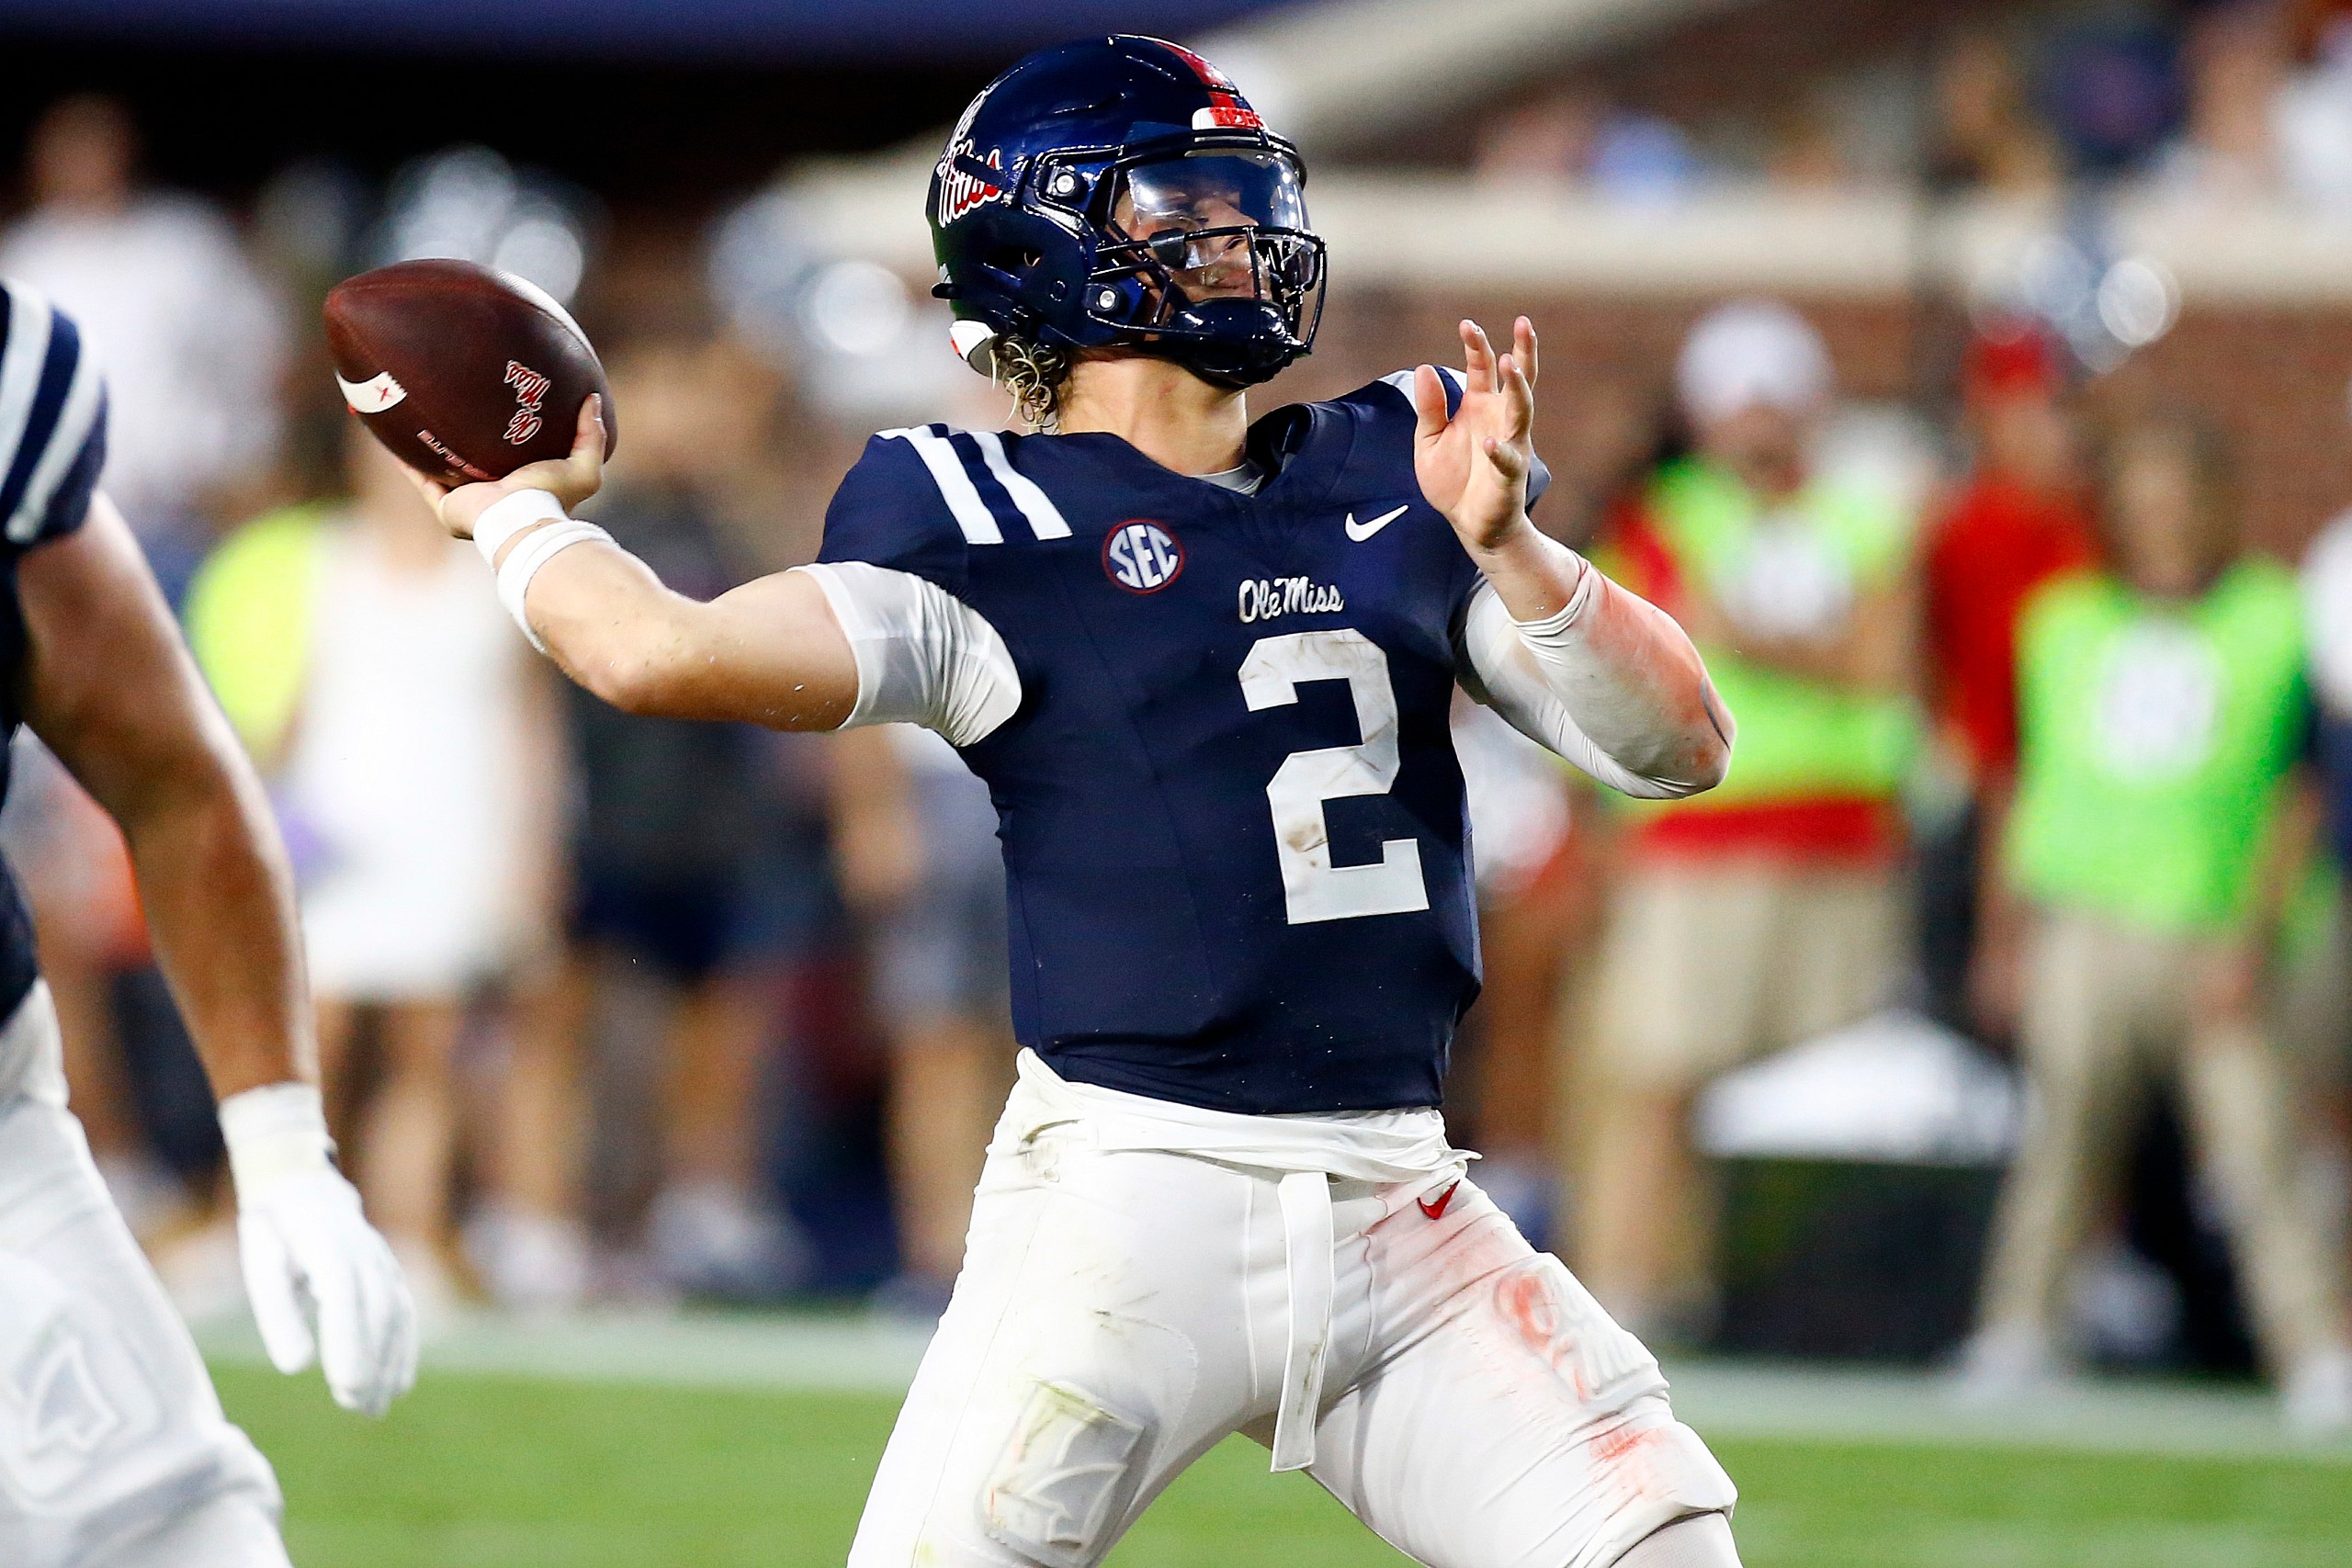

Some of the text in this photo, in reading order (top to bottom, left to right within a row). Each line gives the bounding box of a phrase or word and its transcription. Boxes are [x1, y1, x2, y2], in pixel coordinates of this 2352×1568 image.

[503, 359, 552, 412] Miss
[1108, 523, 1179, 590] SEC
[1238, 575, 1344, 623] Ole Miss
[1238, 627, 1430, 925] 2
